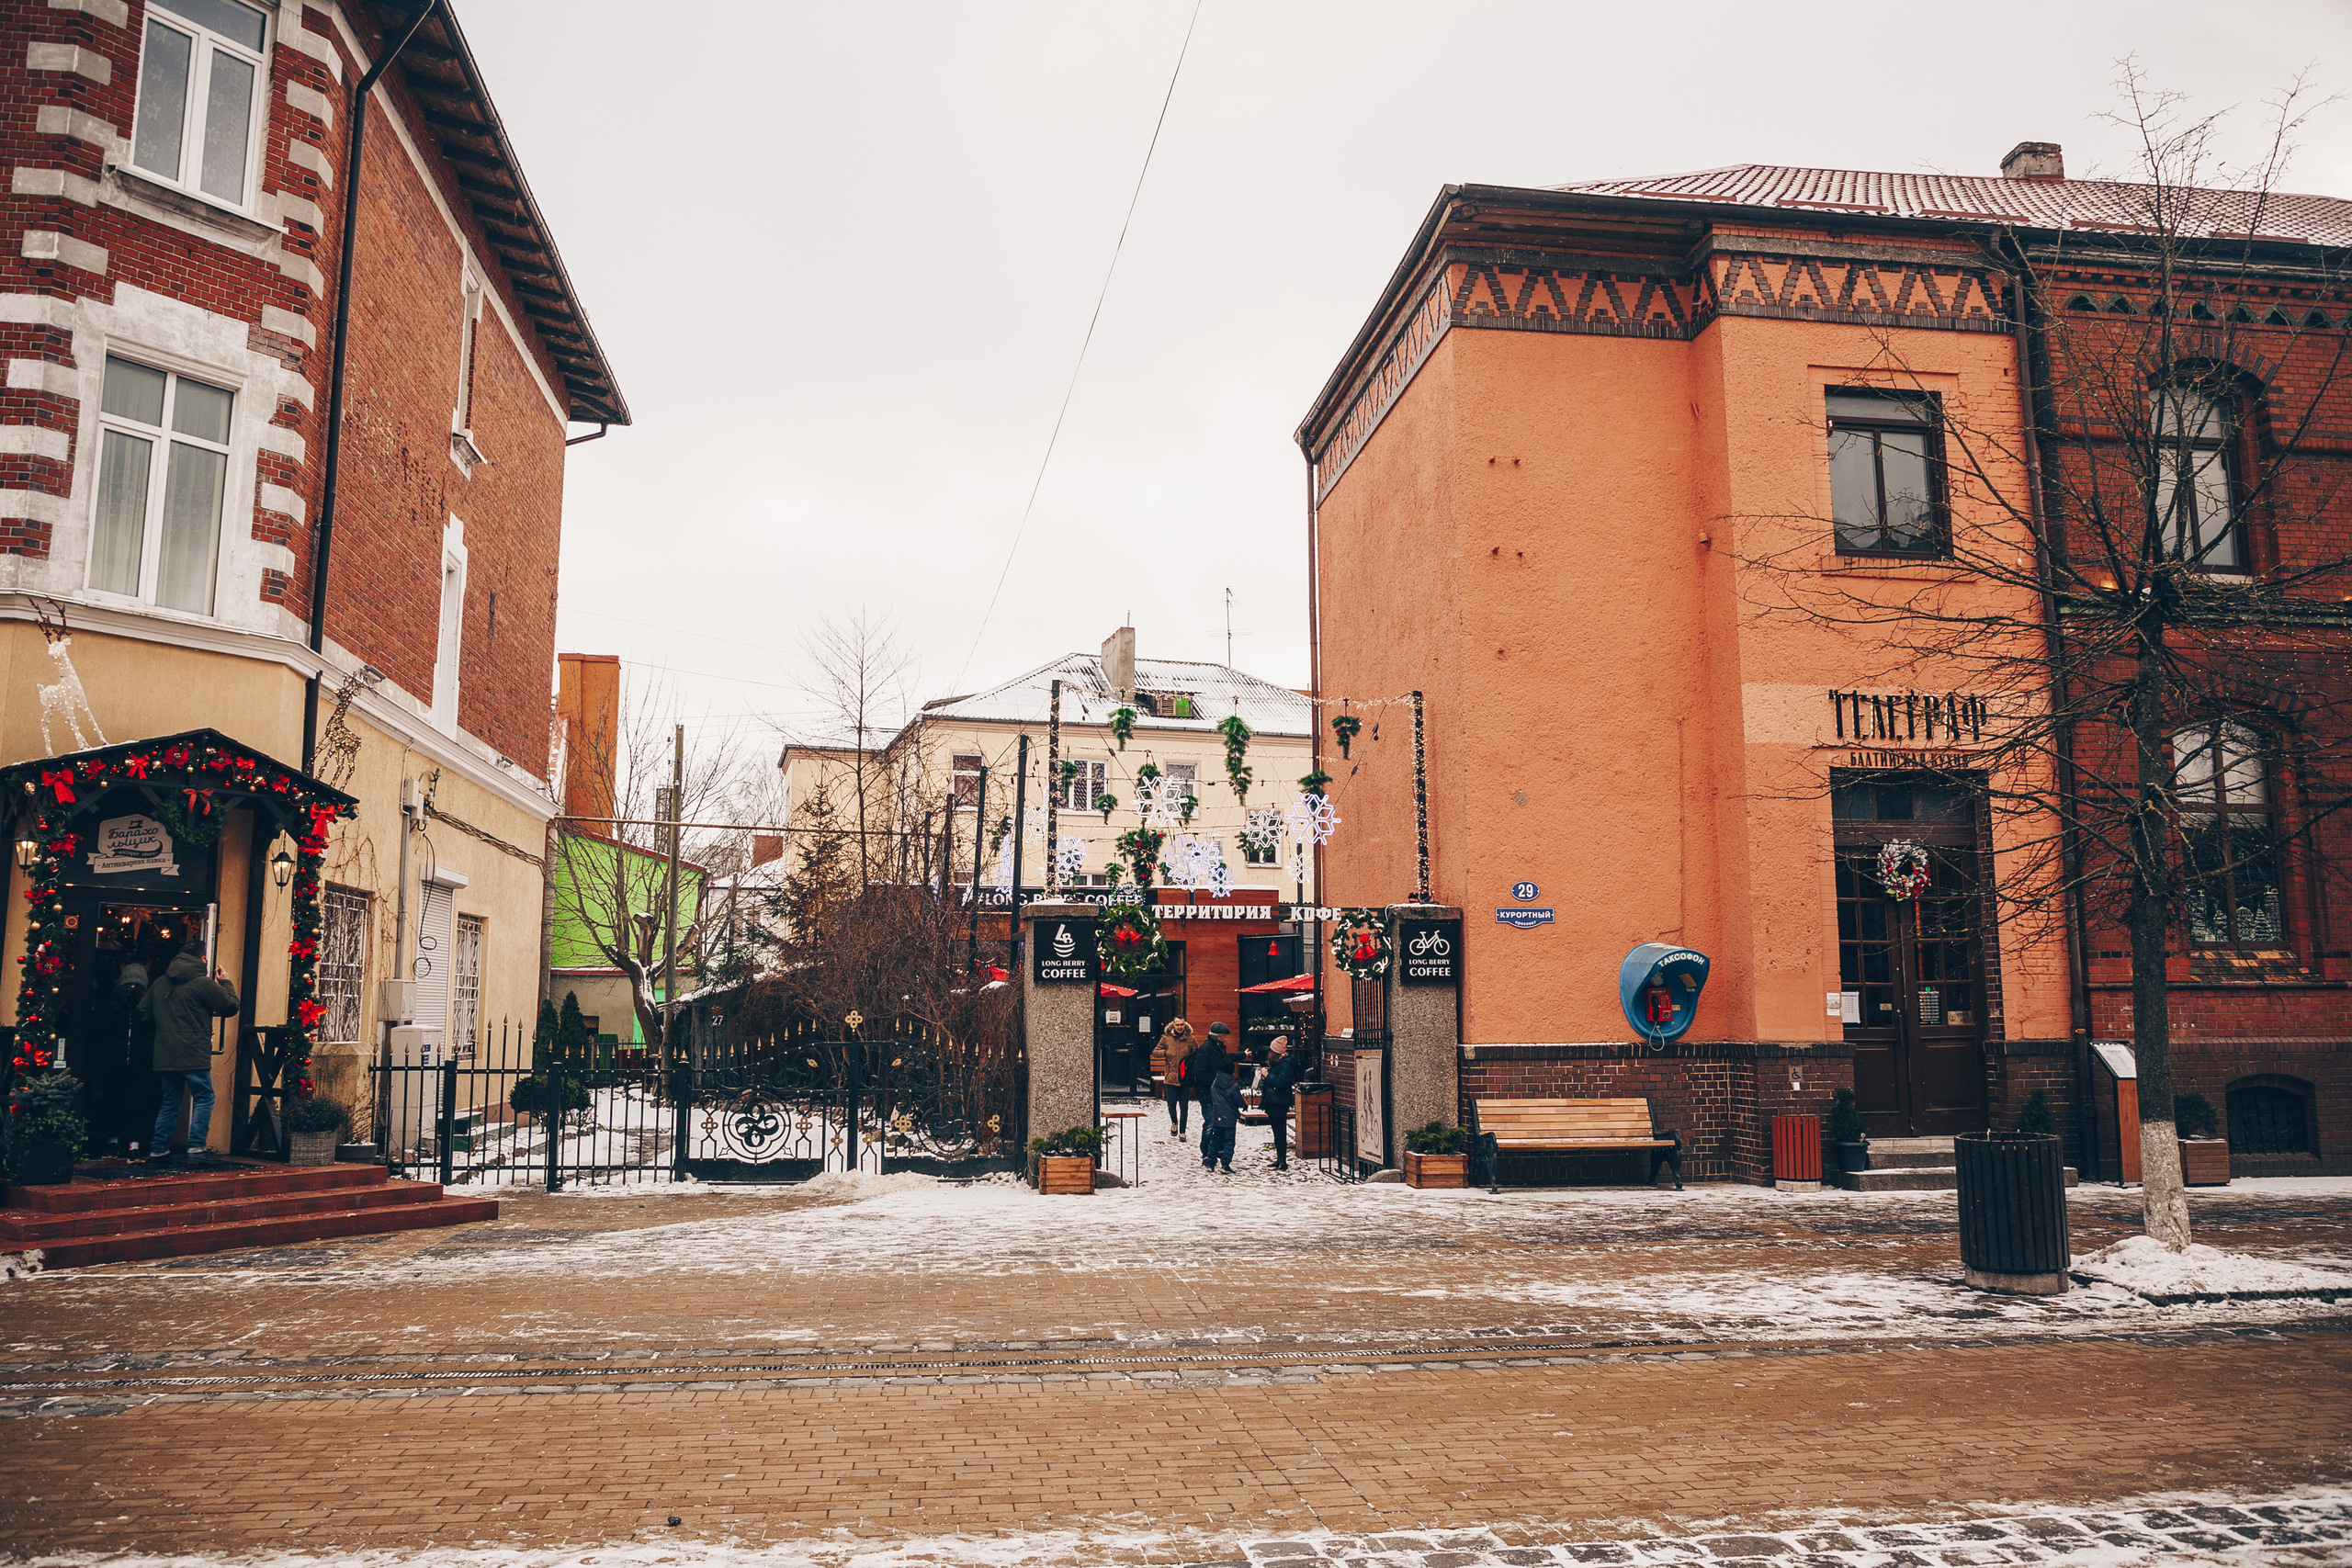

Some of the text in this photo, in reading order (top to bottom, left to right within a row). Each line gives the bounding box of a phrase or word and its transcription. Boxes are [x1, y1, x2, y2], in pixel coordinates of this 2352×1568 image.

[1828, 689, 1987, 740] ТЕЛЕГРАФ
[1518, 884, 1533, 897] 29
[1151, 905, 1341, 921] ТЕРРИТОРИЯ КОФЕ
[1499, 910, 1551, 919] КУРОРТНЫЙ
[1657, 953, 1705, 967] ТАКСОФОН
[1042, 968, 1086, 979] COFFEE
[1409, 967, 1451, 976] COFFEE
[712, 1015, 724, 1025] 27
